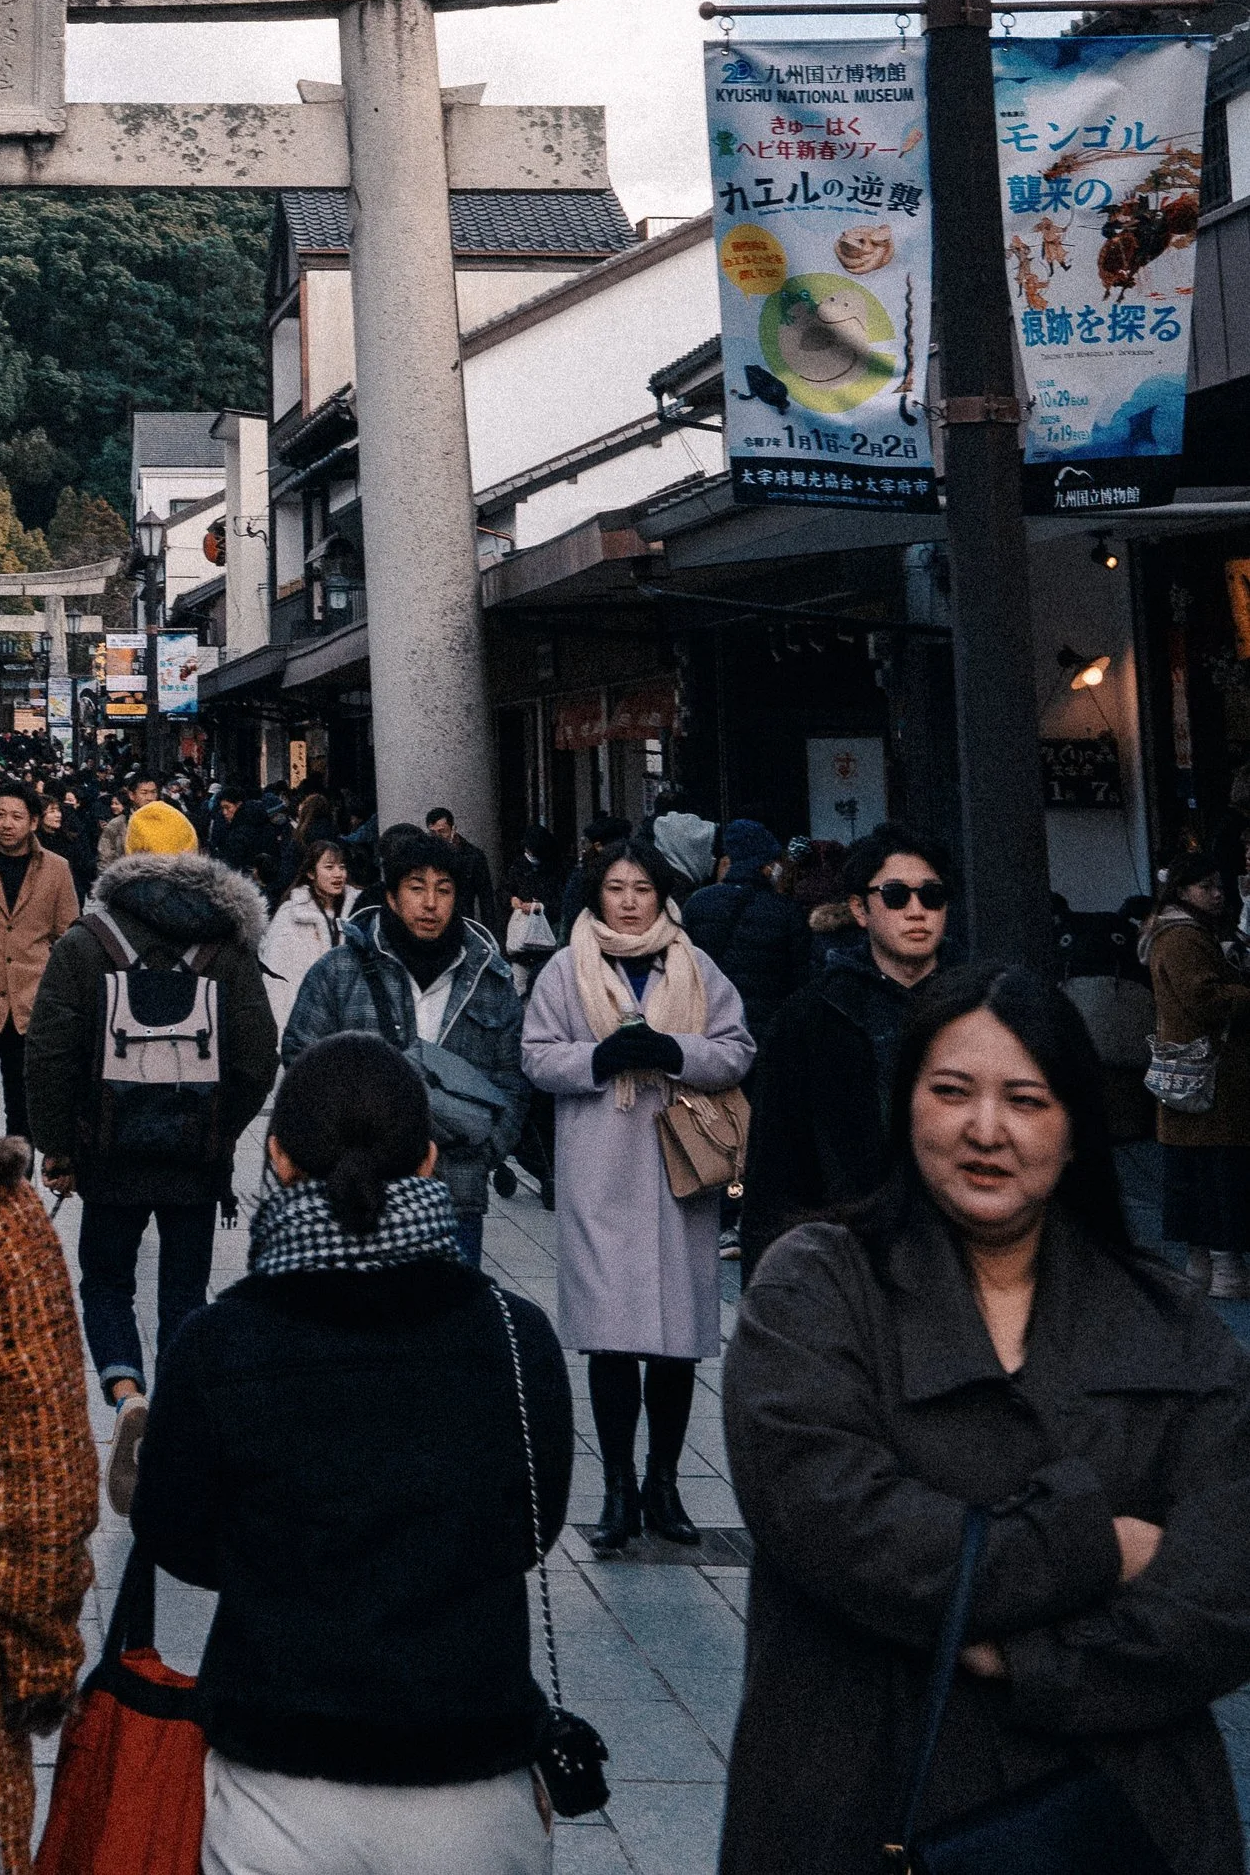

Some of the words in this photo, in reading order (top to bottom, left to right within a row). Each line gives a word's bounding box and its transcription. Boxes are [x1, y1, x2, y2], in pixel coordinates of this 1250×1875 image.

[765, 62, 907, 84] 九州国立博物館
[715, 88, 772, 103] KYUSHU
[776, 89, 849, 103] NATIONAL
[854, 87, 915, 102] MUSEUM
[770, 115, 861, 136] きゅーはく
[1000, 115, 1160, 153] モンゴル
[736, 140, 899, 161] ヘビ年新春ツアー
[719, 171, 924, 217] カエルの逆襲
[1007, 174, 1114, 215] 襲来の
[1021, 303, 1182, 347] 痕跡を探る
[1054, 486, 1141, 508] 九州国立博物館
